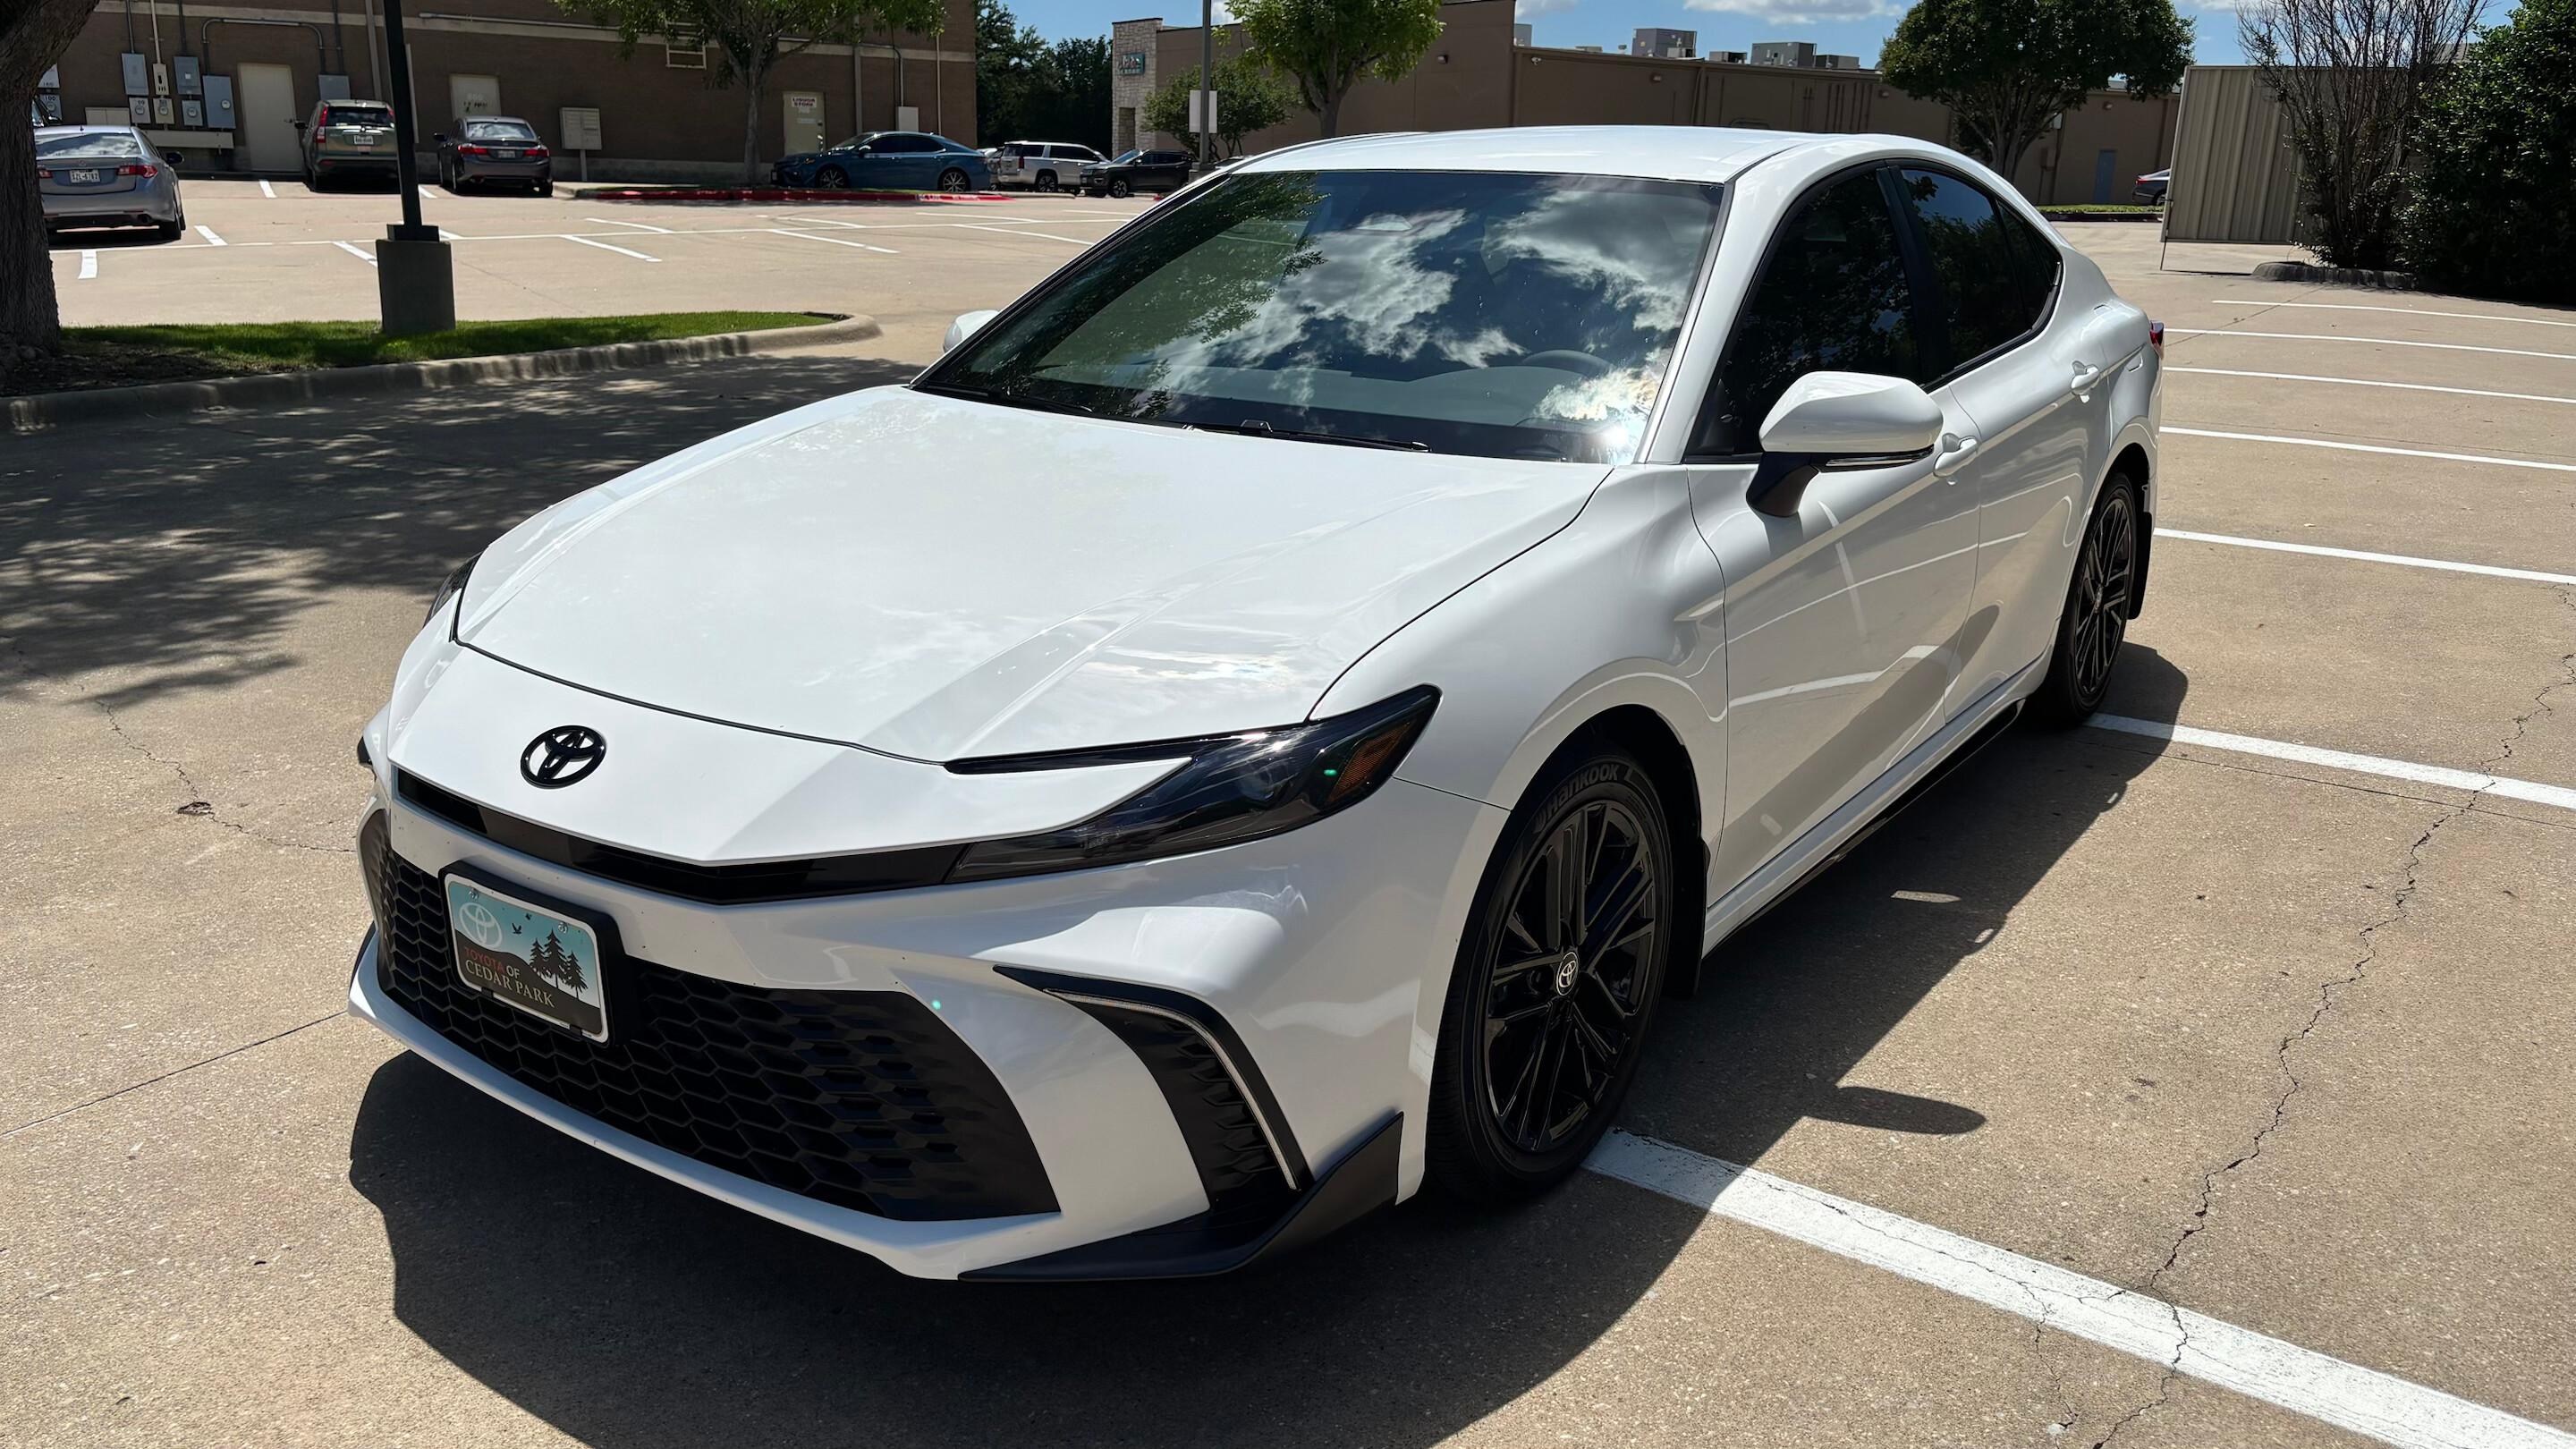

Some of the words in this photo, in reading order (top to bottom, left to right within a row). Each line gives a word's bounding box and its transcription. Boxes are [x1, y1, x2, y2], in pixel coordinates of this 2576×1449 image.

[464, 946, 504, 972] TOYOTA
[506, 965, 521, 978] OF
[465, 960, 513, 991] CEDAR
[516, 981, 555, 1008] PARK
